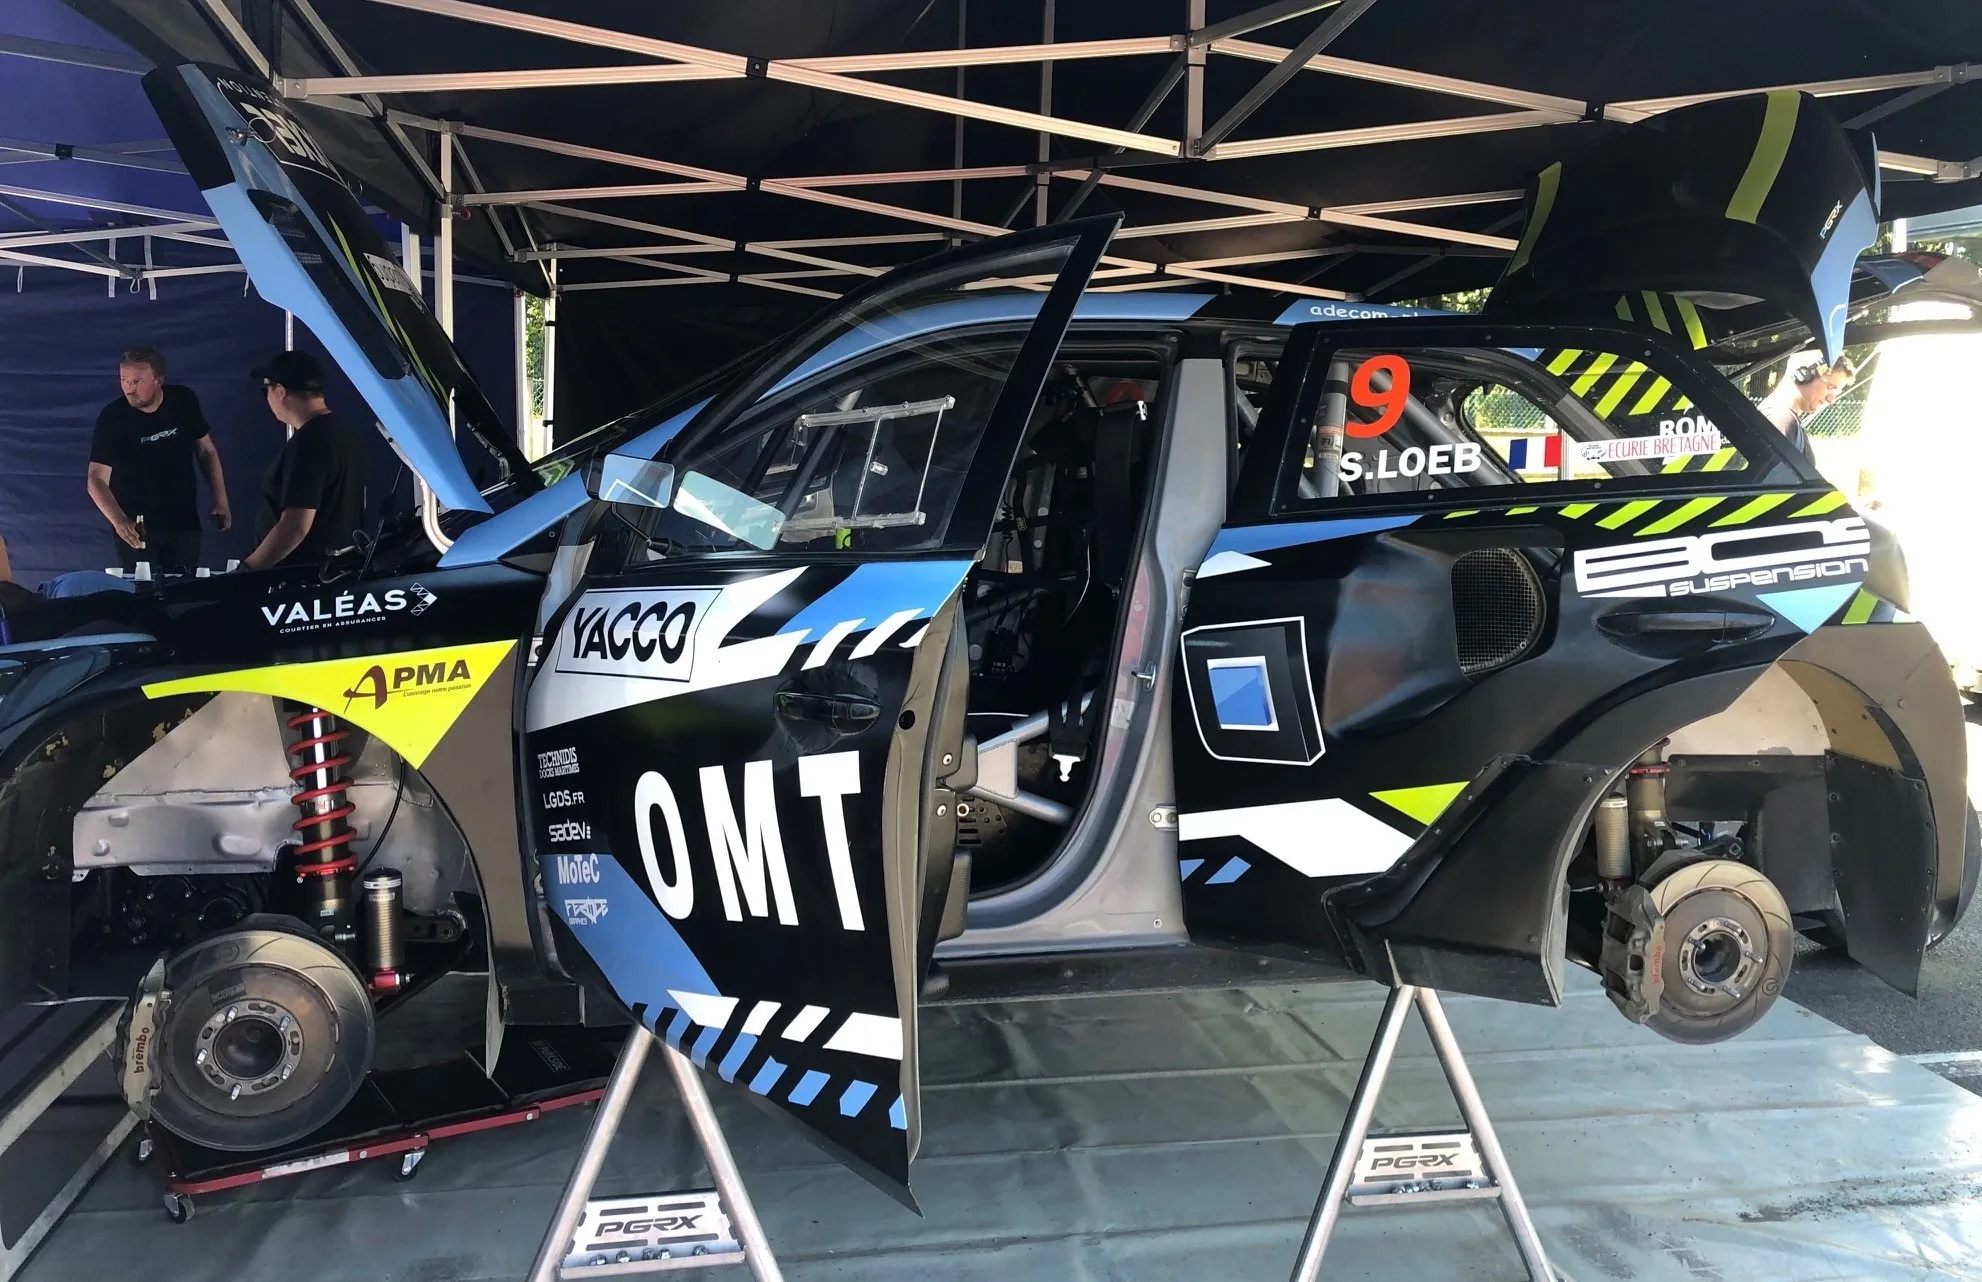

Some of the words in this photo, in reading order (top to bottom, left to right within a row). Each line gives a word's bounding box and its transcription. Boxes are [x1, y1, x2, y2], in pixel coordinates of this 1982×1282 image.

[1820, 200, 1843, 239] PGRX
[1345, 354, 1411, 438] 9
[1608, 440, 1649, 459] ECURIE
[1653, 434, 1717, 456] BRETAGNE
[1338, 442, 1482, 482] S.LOEB
[261, 590, 407, 626] VALÉAS
[279, 624, 320, 634] COURTIER
[335, 616, 387, 627] ASSURANCES
[572, 601, 696, 664] YACCO
[431, 686, 448, 694] notre
[447, 683, 472, 693] passion
[537, 747, 578, 769] TECHNIDIS
[539, 767, 555, 779] DOCKS
[554, 763, 580, 777] MARITIMES
[543, 790, 585, 809] LGDS.FR
[634, 750, 866, 931] OMT
[557, 853, 600, 884] MoTeC
[134, 1026, 150, 1074] brembo
[1370, 1152, 1461, 1171] PGRX
[594, 1214, 703, 1238] PGRX
